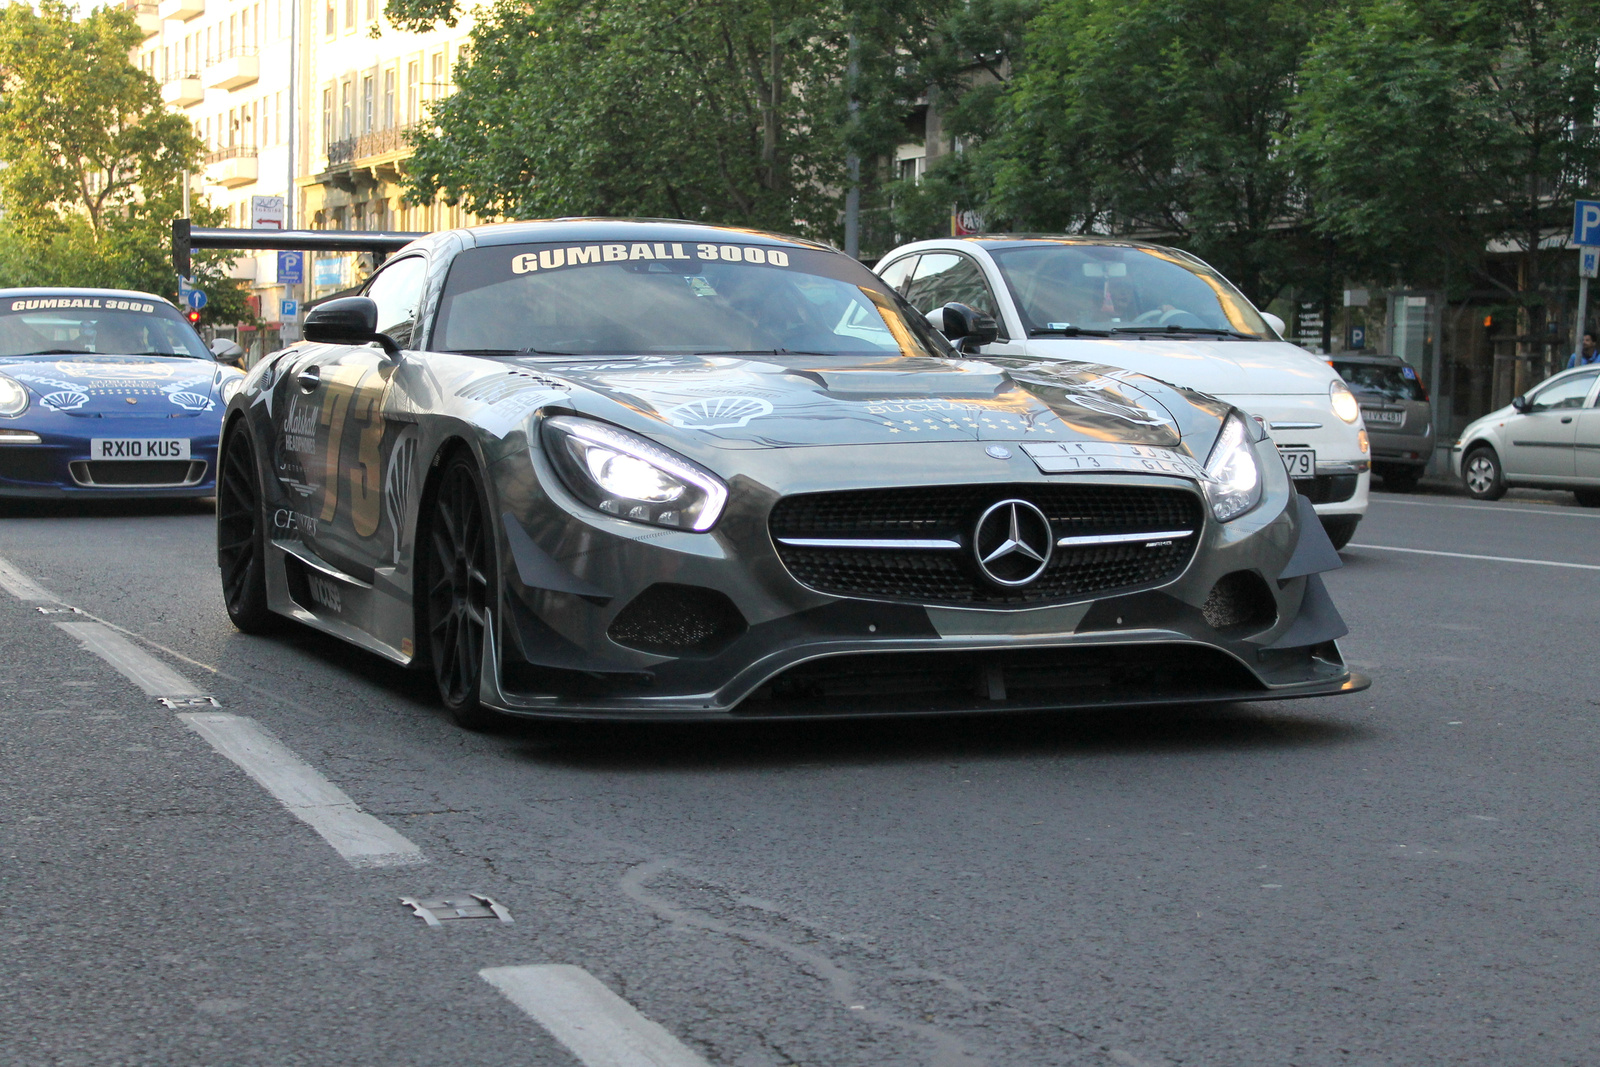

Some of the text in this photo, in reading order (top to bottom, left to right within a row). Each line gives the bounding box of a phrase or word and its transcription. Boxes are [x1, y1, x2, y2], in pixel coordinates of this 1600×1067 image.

[1580, 205, 1600, 241] P
[285, 257, 297, 271] P
[511, 243, 789, 275] GUMBALL 3000
[12, 299, 154, 313] GUMBALL 3000
[284, 302, 293, 314] P
[1352, 329, 1363, 344] P
[102, 441, 180, 456] RX10 KUS
[319, 364, 392, 538] 73
[1281, 454, 1309, 473] 79
